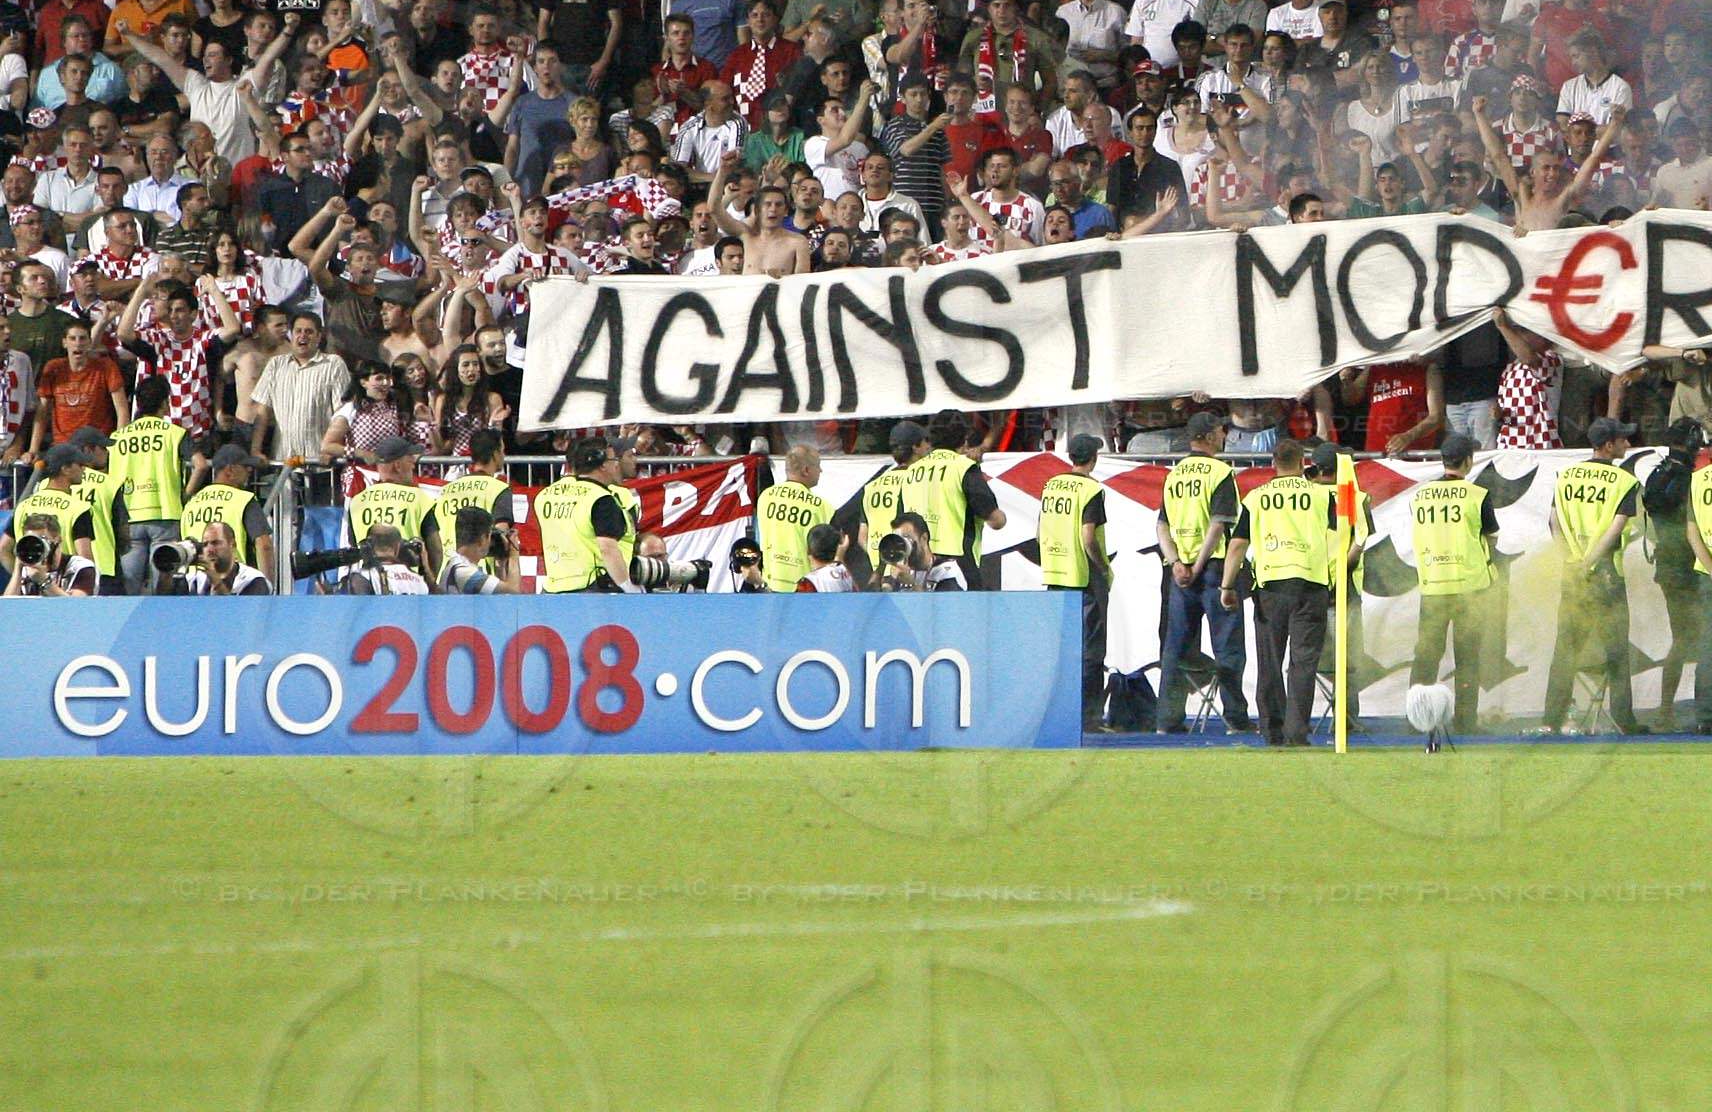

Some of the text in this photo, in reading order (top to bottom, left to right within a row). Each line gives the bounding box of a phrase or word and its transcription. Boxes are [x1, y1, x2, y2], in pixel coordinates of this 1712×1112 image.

[539, 250, 1122, 424] AGAINST
[117, 434, 164, 456] 0885
[1564, 466, 1618, 484] STEWARD
[360, 488, 416, 504] STEWARD
[768, 485, 823, 508] STEWARD
[1260, 492, 1312, 511] 0010
[1414, 486, 1468, 502] STEWARD
[1563, 483, 1607, 505] 0424
[362, 506, 408, 527] 0351
[766, 501, 812, 527] 0880
[1416, 504, 1462, 525] 0113
